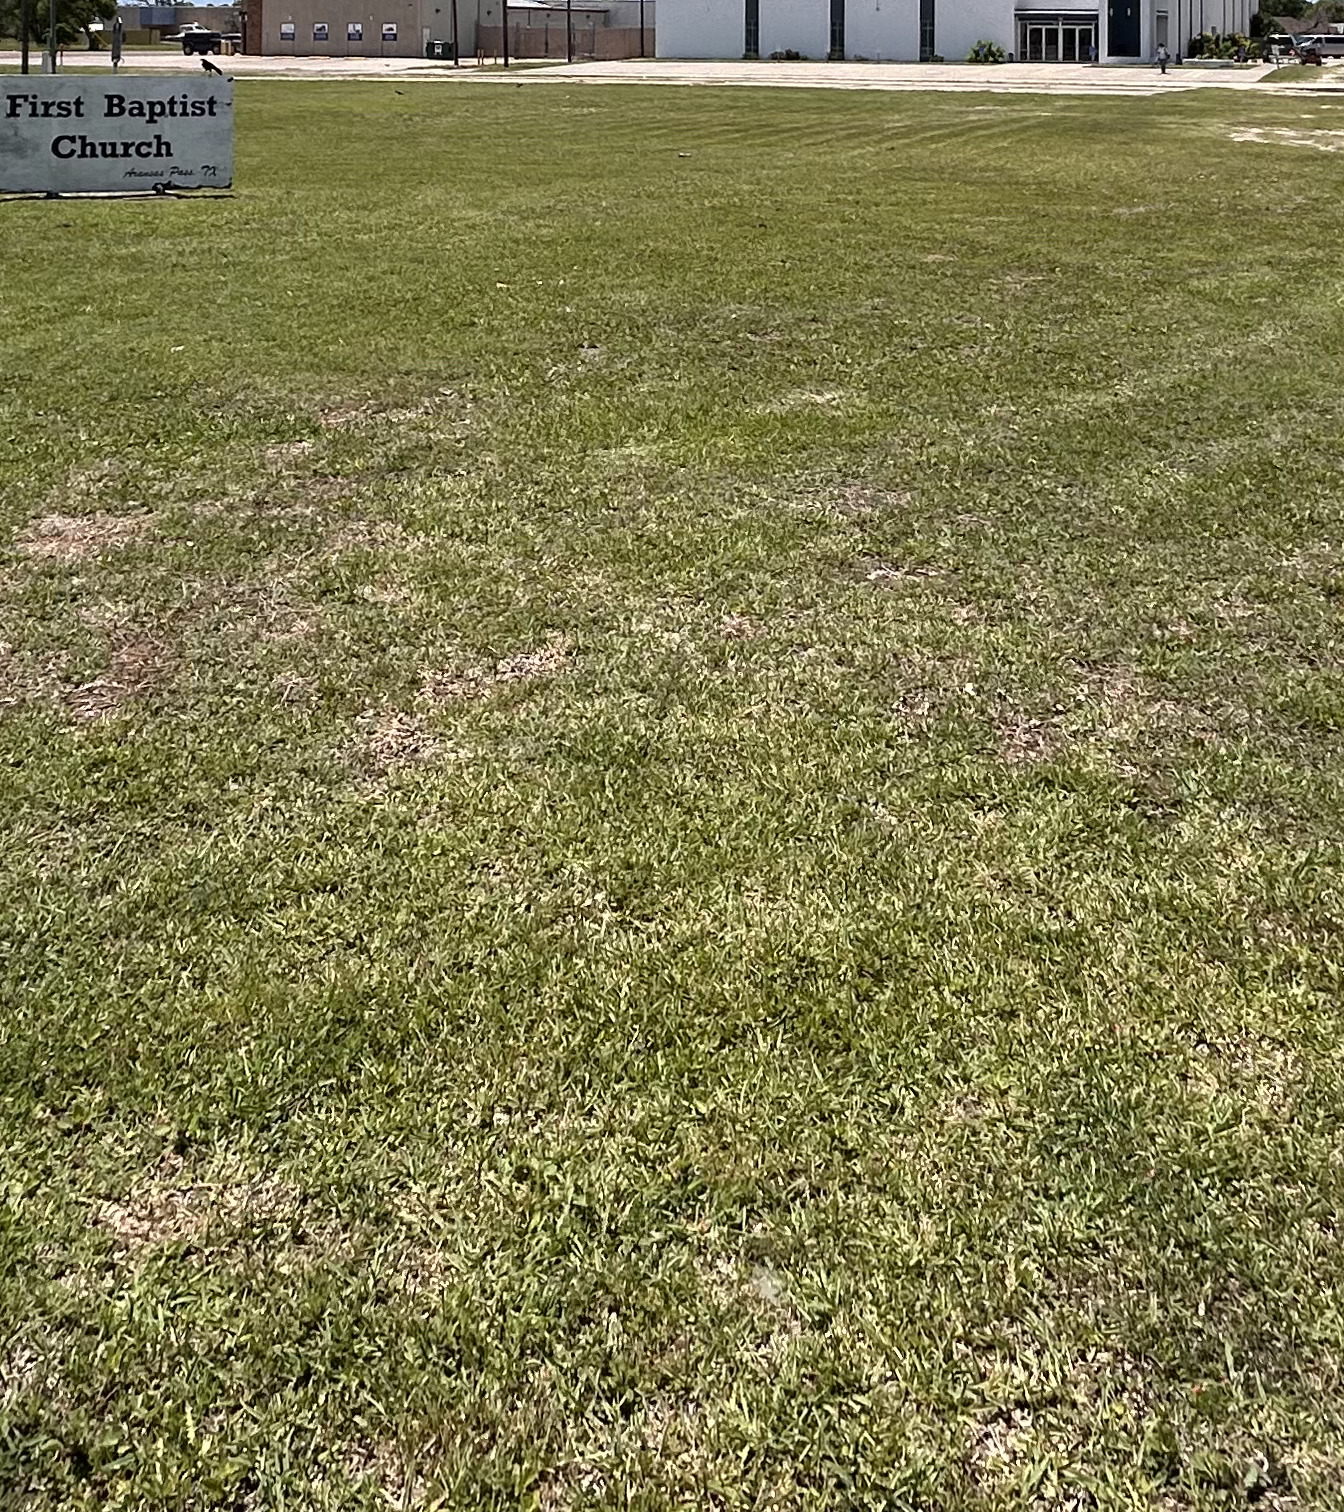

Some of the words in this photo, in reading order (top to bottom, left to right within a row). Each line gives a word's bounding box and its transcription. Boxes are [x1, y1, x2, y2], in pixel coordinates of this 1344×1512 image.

[6, 94, 84, 118] First
[104, 94, 217, 123] Baptist
[51, 135, 173, 158] Church
[201, 164, 217, 177] TX
